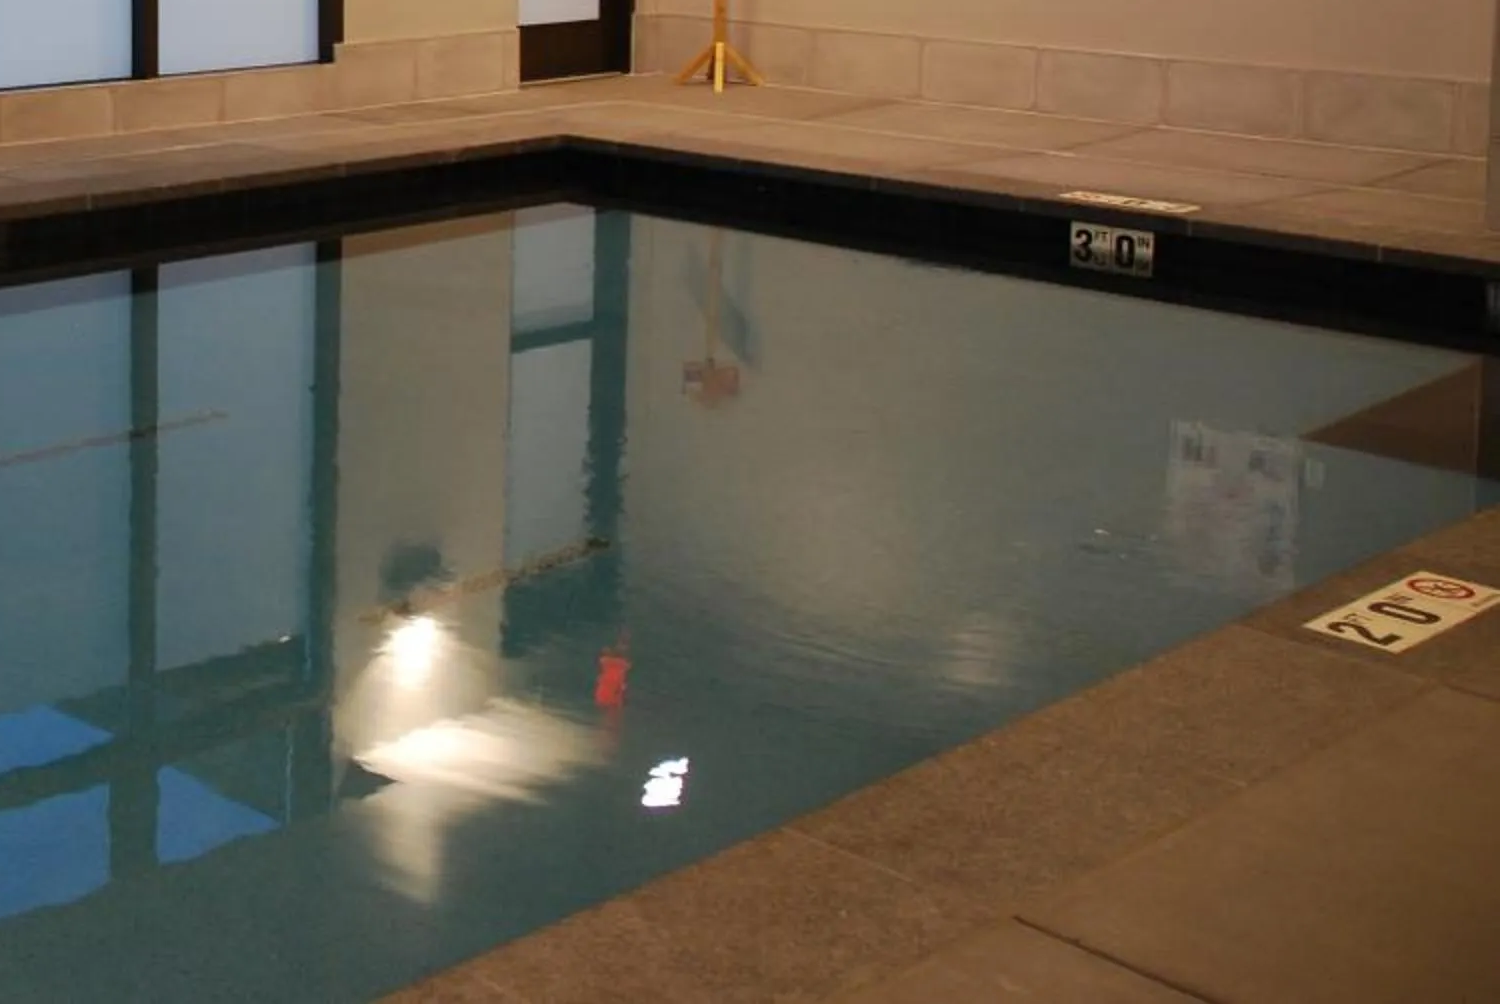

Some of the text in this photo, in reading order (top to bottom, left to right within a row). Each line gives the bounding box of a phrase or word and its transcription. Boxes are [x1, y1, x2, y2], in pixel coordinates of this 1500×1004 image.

[1115, 234, 1135, 268] 0
[1327, 621, 1404, 646] 2
[1367, 602, 1441, 625] 0
